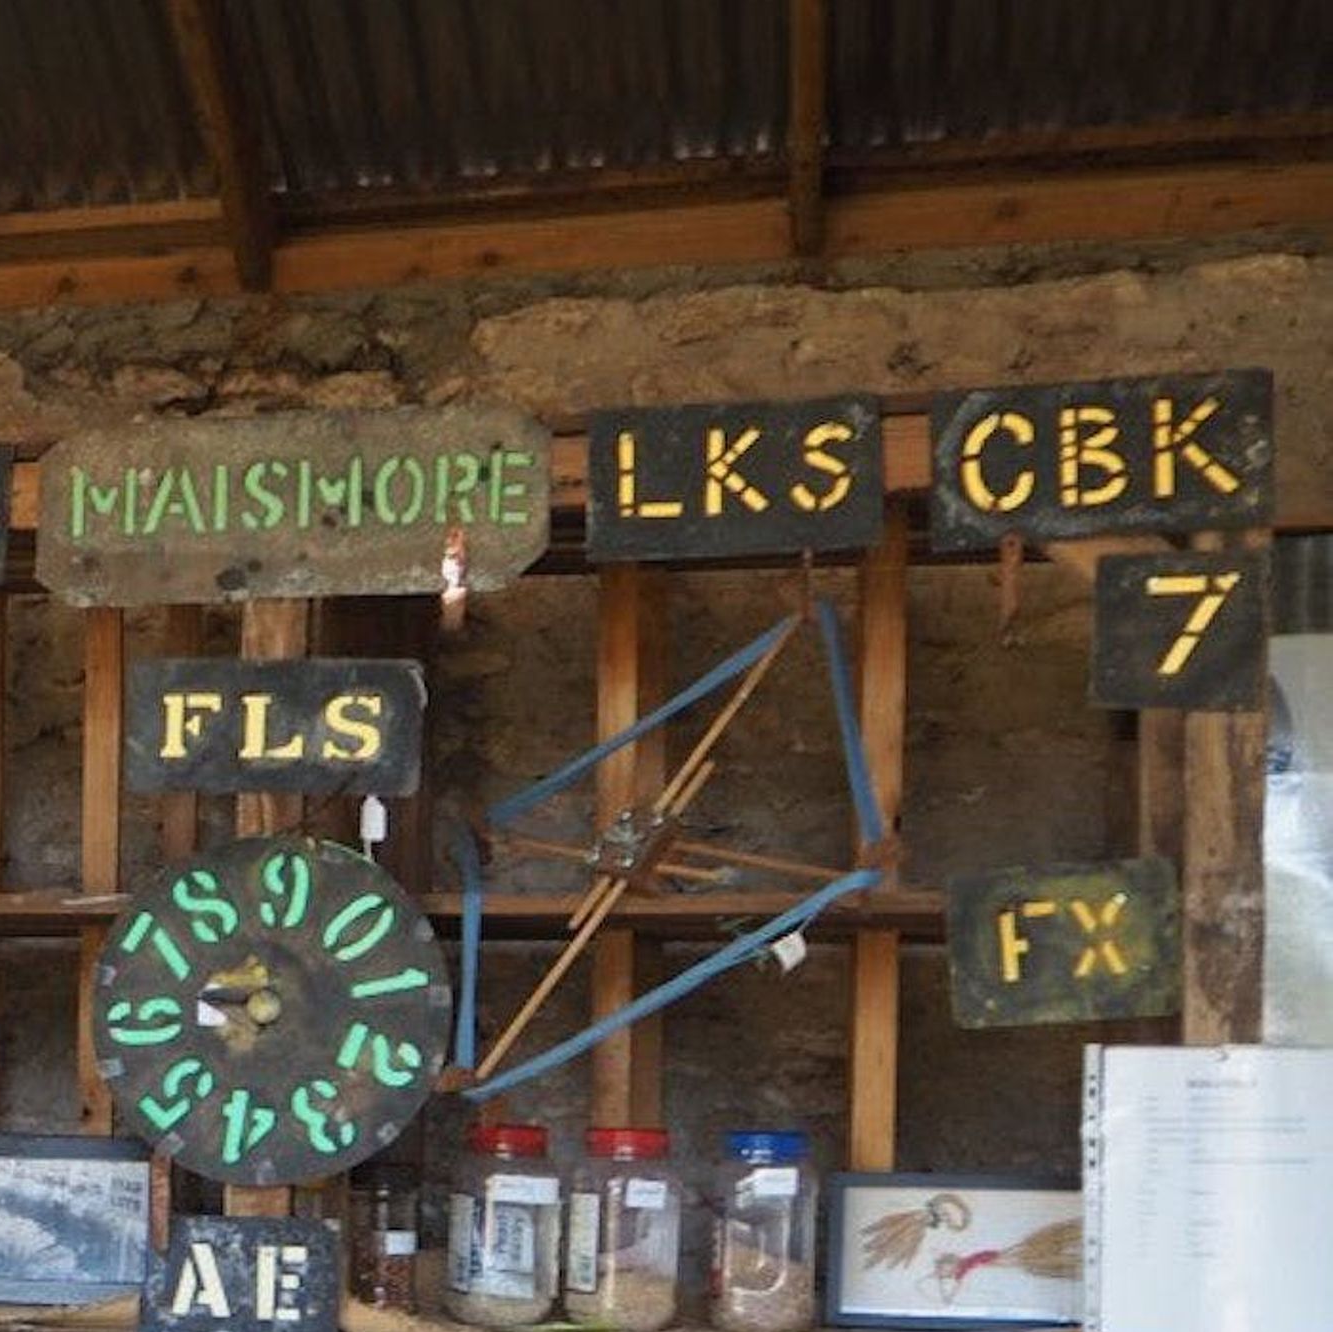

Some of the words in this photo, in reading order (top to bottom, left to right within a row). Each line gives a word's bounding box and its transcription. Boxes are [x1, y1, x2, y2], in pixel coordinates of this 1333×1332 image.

[616, 422, 857, 519] LKS
[960, 397, 1240, 513] CBK
[70, 450, 535, 540] MAISMORE
[1147, 572, 1240, 676] 7
[159, 692, 383, 762] FLS
[172, 870, 240, 943] 8
[260, 853, 311, 928] 9
[322, 893, 396, 961] 0
[122, 912, 192, 981] 7
[997, 892, 1129, 983] FX
[107, 995, 183, 1046] 6
[349, 967, 431, 999] 1
[337, 1022, 423, 1088] 2
[139, 1057, 214, 1133] 5
[221, 1090, 278, 1165] 4
[290, 1079, 357, 1154] 3
[171, 1242, 309, 1322] AE
